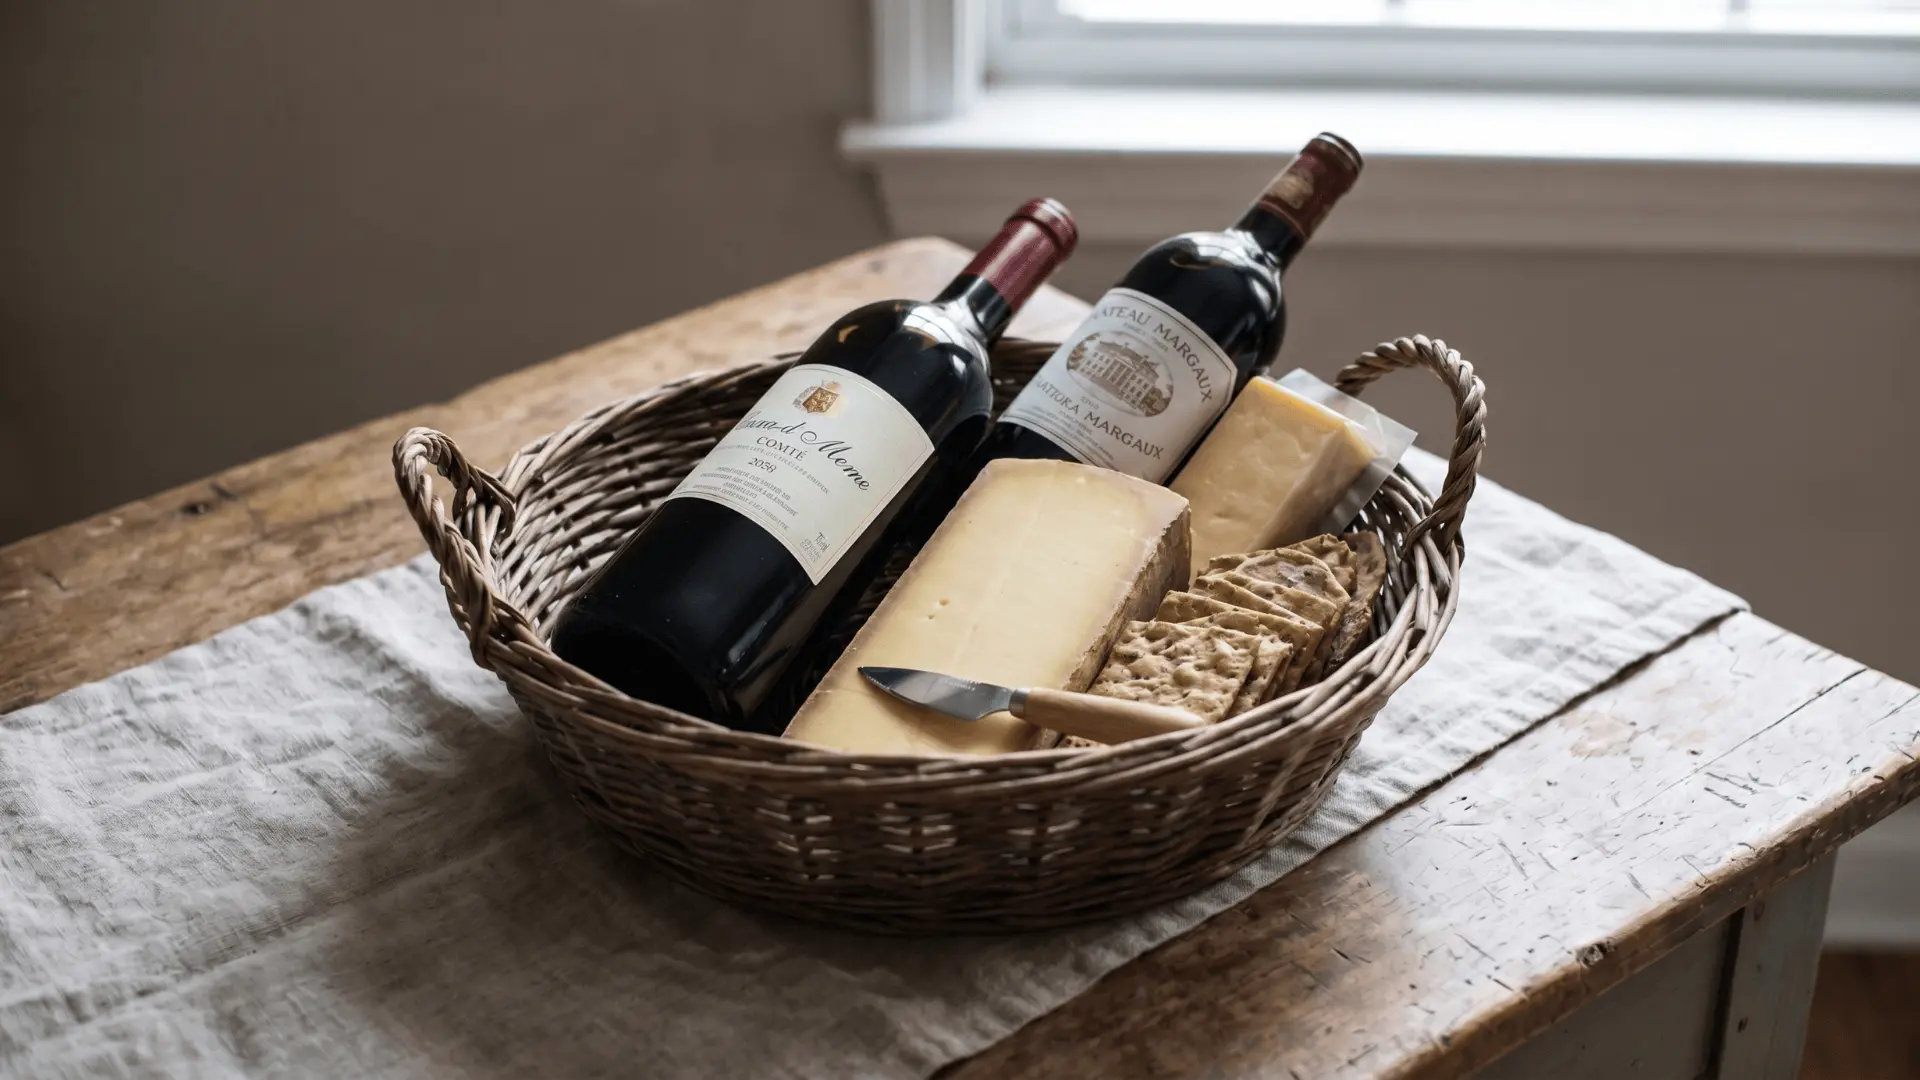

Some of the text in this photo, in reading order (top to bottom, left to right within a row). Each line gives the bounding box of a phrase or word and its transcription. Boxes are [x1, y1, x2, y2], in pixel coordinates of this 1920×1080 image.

[1094, 306, 1152, 326] ATEAU
[1153, 323, 1213, 404] MARGAUX
[757, 436, 808, 462] COMTÉ
[1083, 411, 1164, 460] MARGAUX
